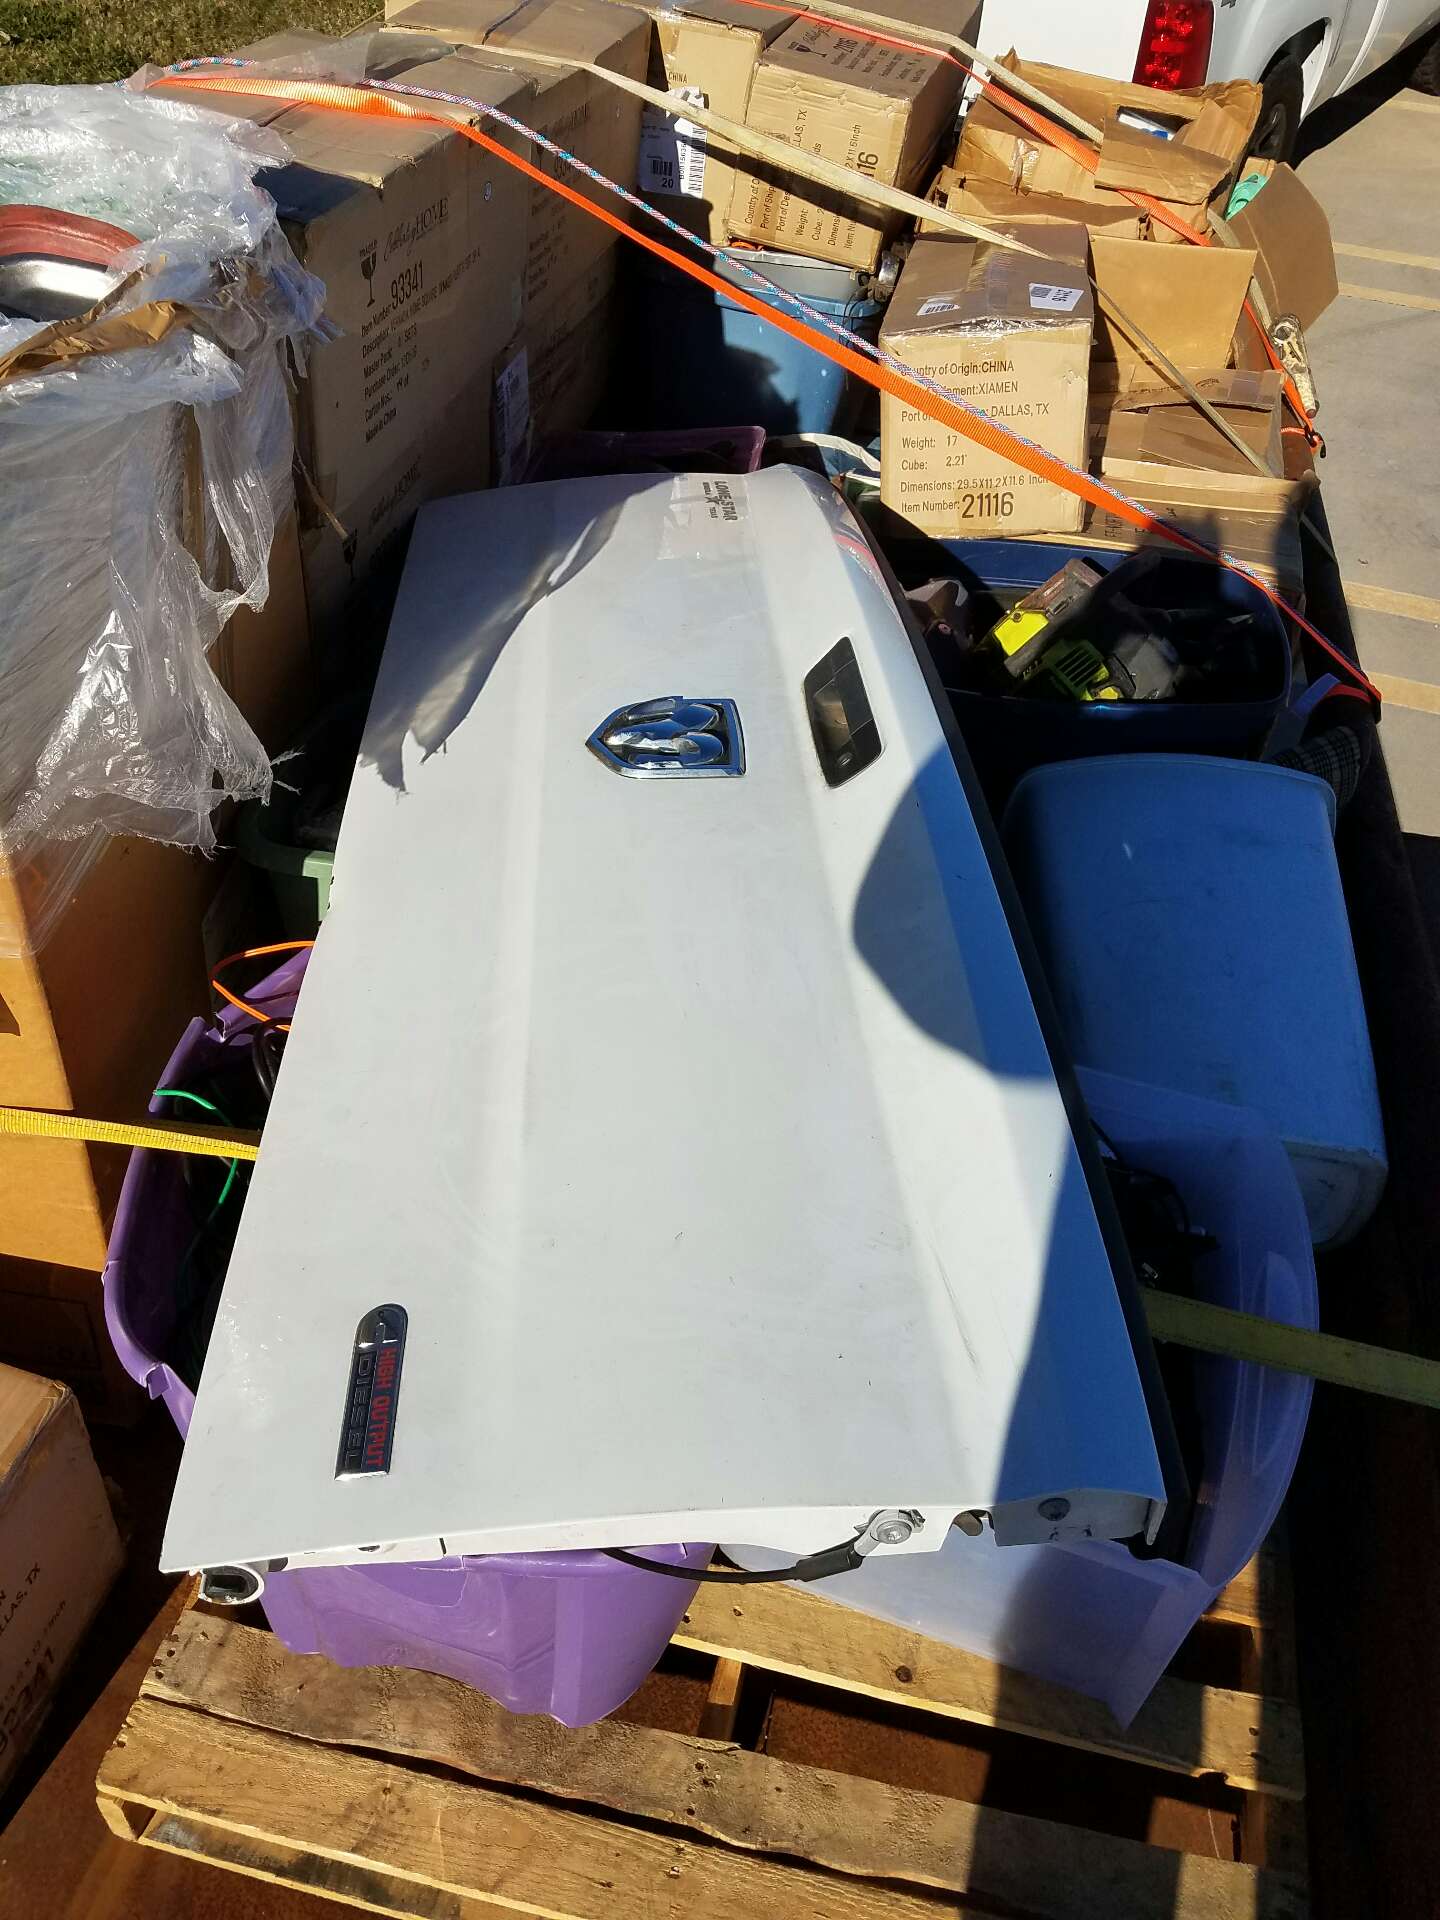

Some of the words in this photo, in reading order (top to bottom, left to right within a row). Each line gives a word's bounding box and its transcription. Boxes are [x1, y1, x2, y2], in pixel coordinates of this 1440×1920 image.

[668, 71, 688, 83] CHINA
[797, 108, 808, 121] TX
[856, 151, 879, 178] 116
[661, 178, 674, 189] 20
[745, 195, 760, 224] Country
[795, 208, 809, 236] Weight:
[812, 218, 823, 241] Cube:
[827, 215, 840, 246] Dimensi
[391, 259, 423, 310] 93341
[938, 363, 949, 375] of
[901, 410, 920, 422] Port
[991, 404, 1033, 418] DALLAS,
[1035, 402, 1050, 416] TX
[902, 437, 936, 450] Weight:
[946, 435, 958, 447] 17
[901, 459, 928, 471] Cube:
[900, 480, 955, 493] Dimensions:
[901, 503, 920, 513] Item
[922, 499, 960, 512] Number:
[961, 491, 1015, 519] 21116
[377, 1347, 397, 1389] HIGH
[344, 1352, 371, 1469] DIESEL
[367, 1395, 393, 1467] OUTPUT
[24, 1561, 41, 1586] TX
